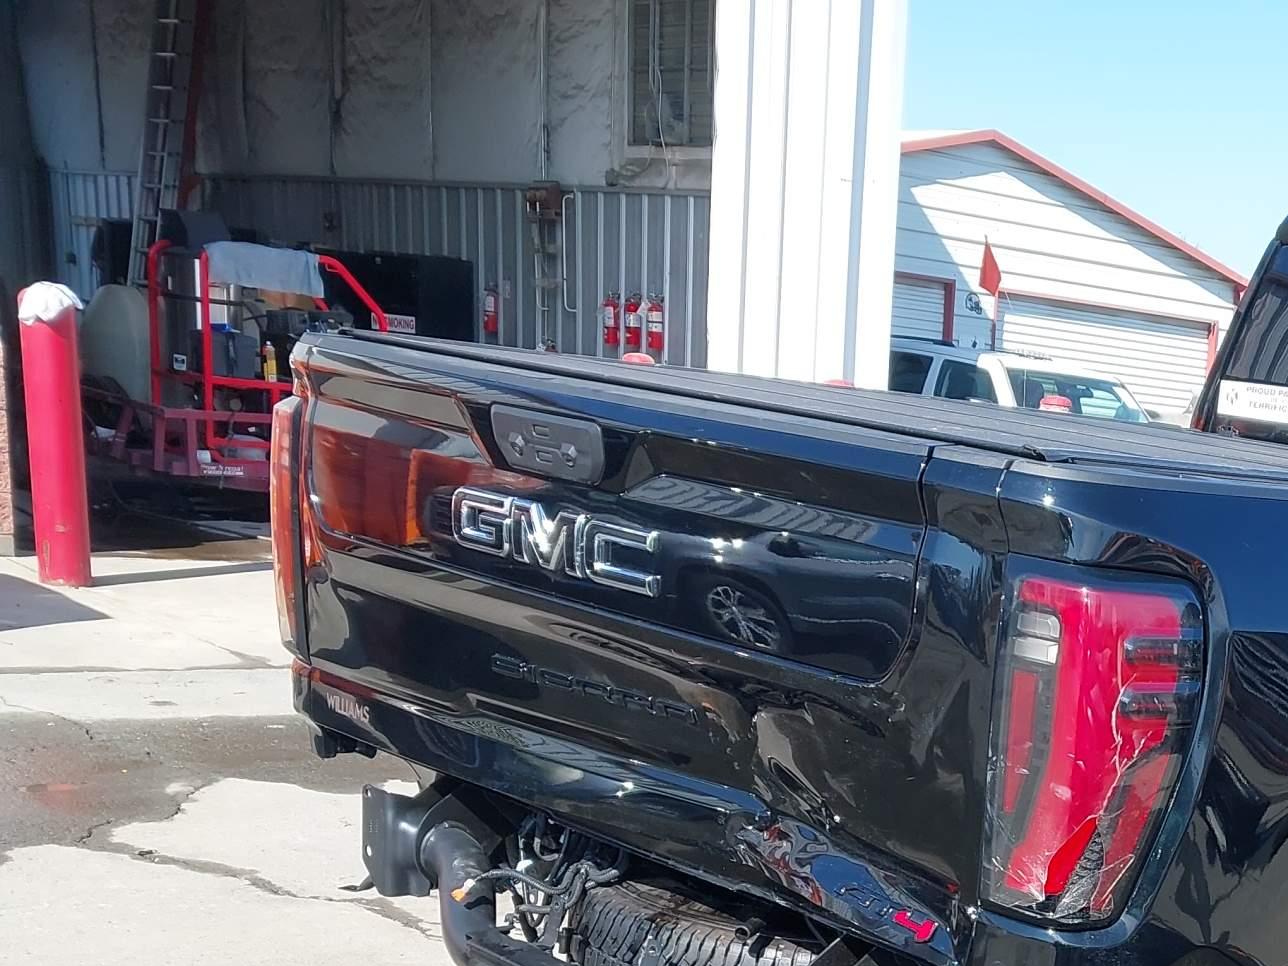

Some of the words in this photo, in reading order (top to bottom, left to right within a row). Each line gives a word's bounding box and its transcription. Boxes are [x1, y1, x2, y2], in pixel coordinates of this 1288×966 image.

[1246, 386, 1276, 396] PROUD
[451, 486, 661, 597] GMC
[326, 691, 370, 722] WILLIAMS
[490, 652, 700, 728] SIERRA
